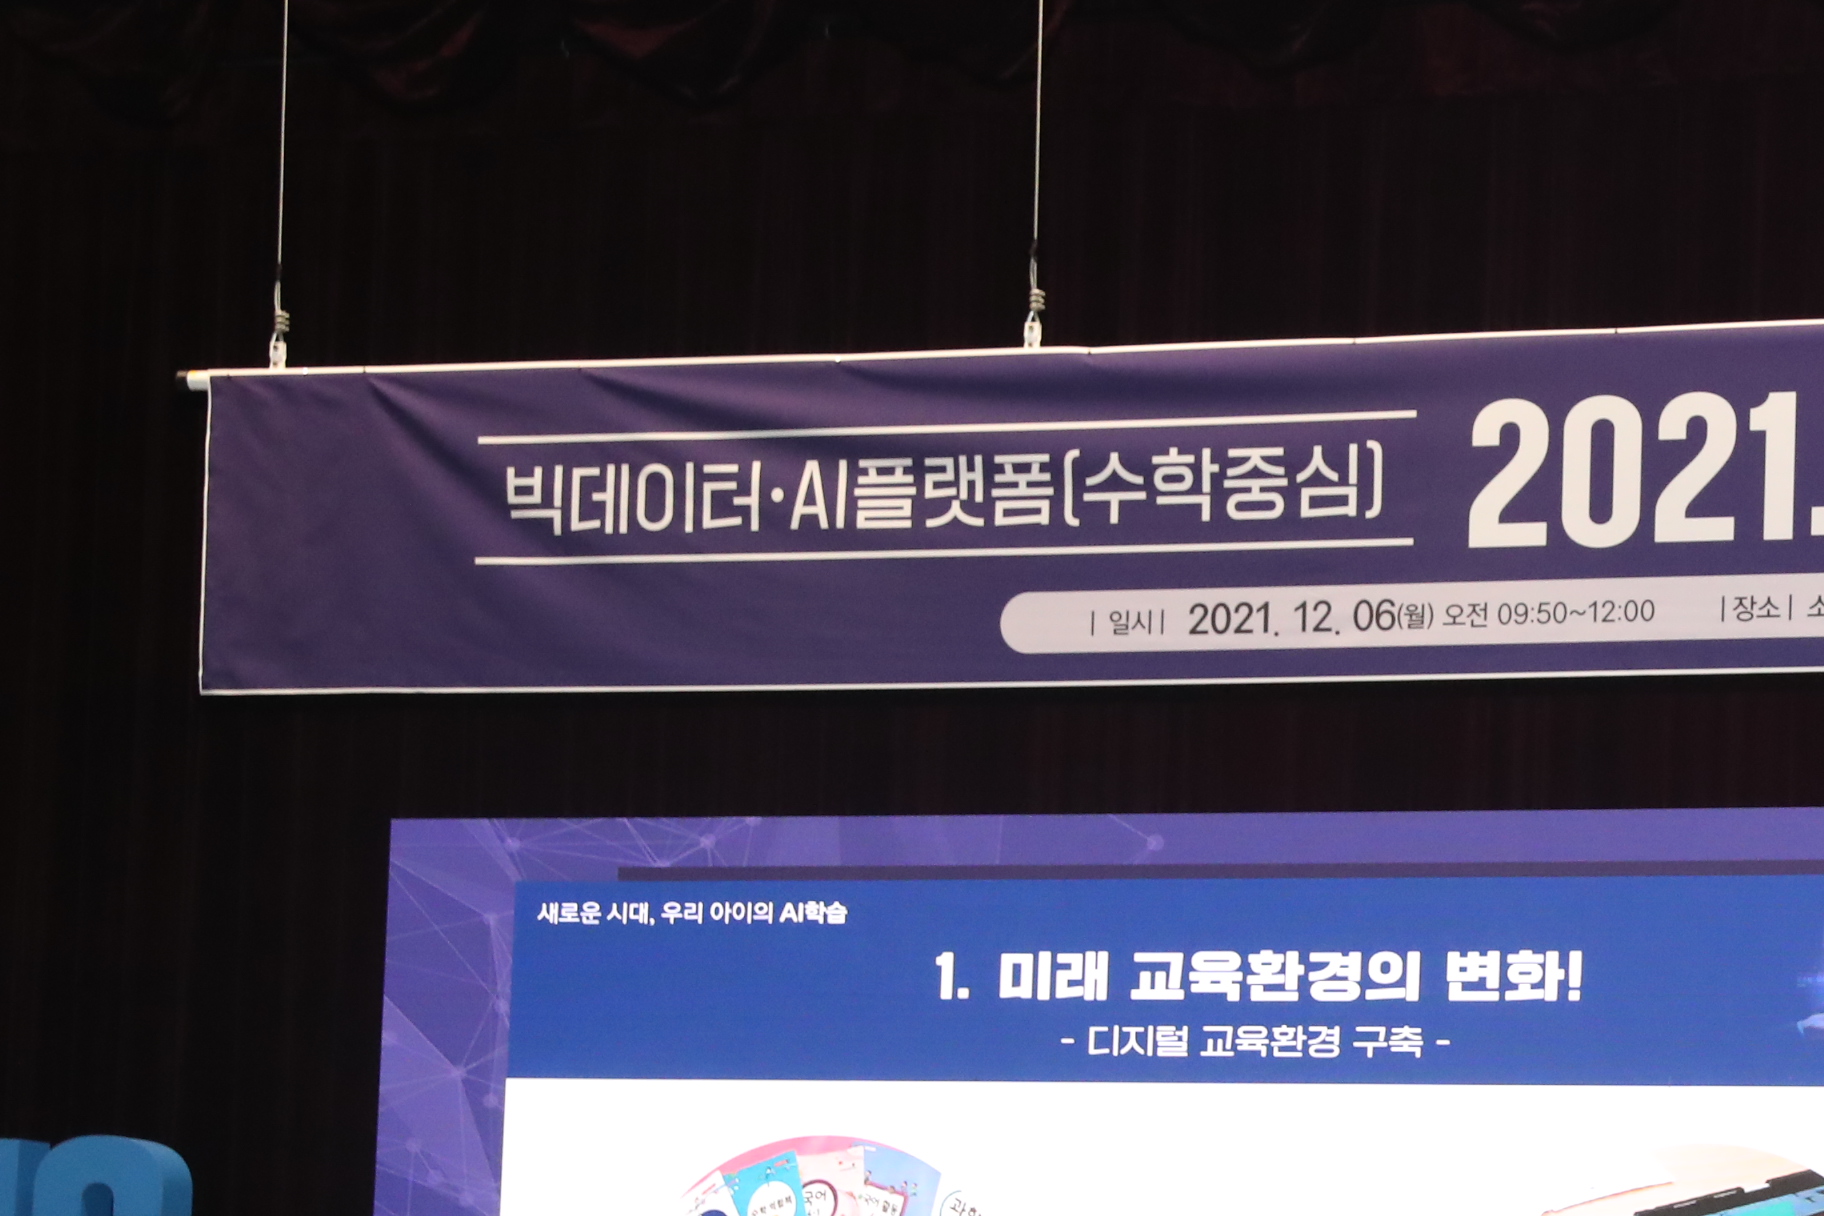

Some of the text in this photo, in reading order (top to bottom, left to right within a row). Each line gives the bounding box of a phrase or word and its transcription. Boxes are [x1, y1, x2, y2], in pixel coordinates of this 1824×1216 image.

[1188, 603, 1279, 638] 2021.
[1295, 602, 1341, 637] 12.
[1443, 603, 1488, 630] 오전
[1497, 599, 1655, 626] 09:50~12:00
[537, 900, 847, 926] 새로운 시대, 우리 아이의 AI학습
[935, 949, 1584, 1002] 1. 미래 교육환경의 변화!
[1087, 1025, 1189, 1058] 디지털
[1200, 1024, 1341, 1058] 교육환경
[1353, 1026, 1424, 1058] 구축
